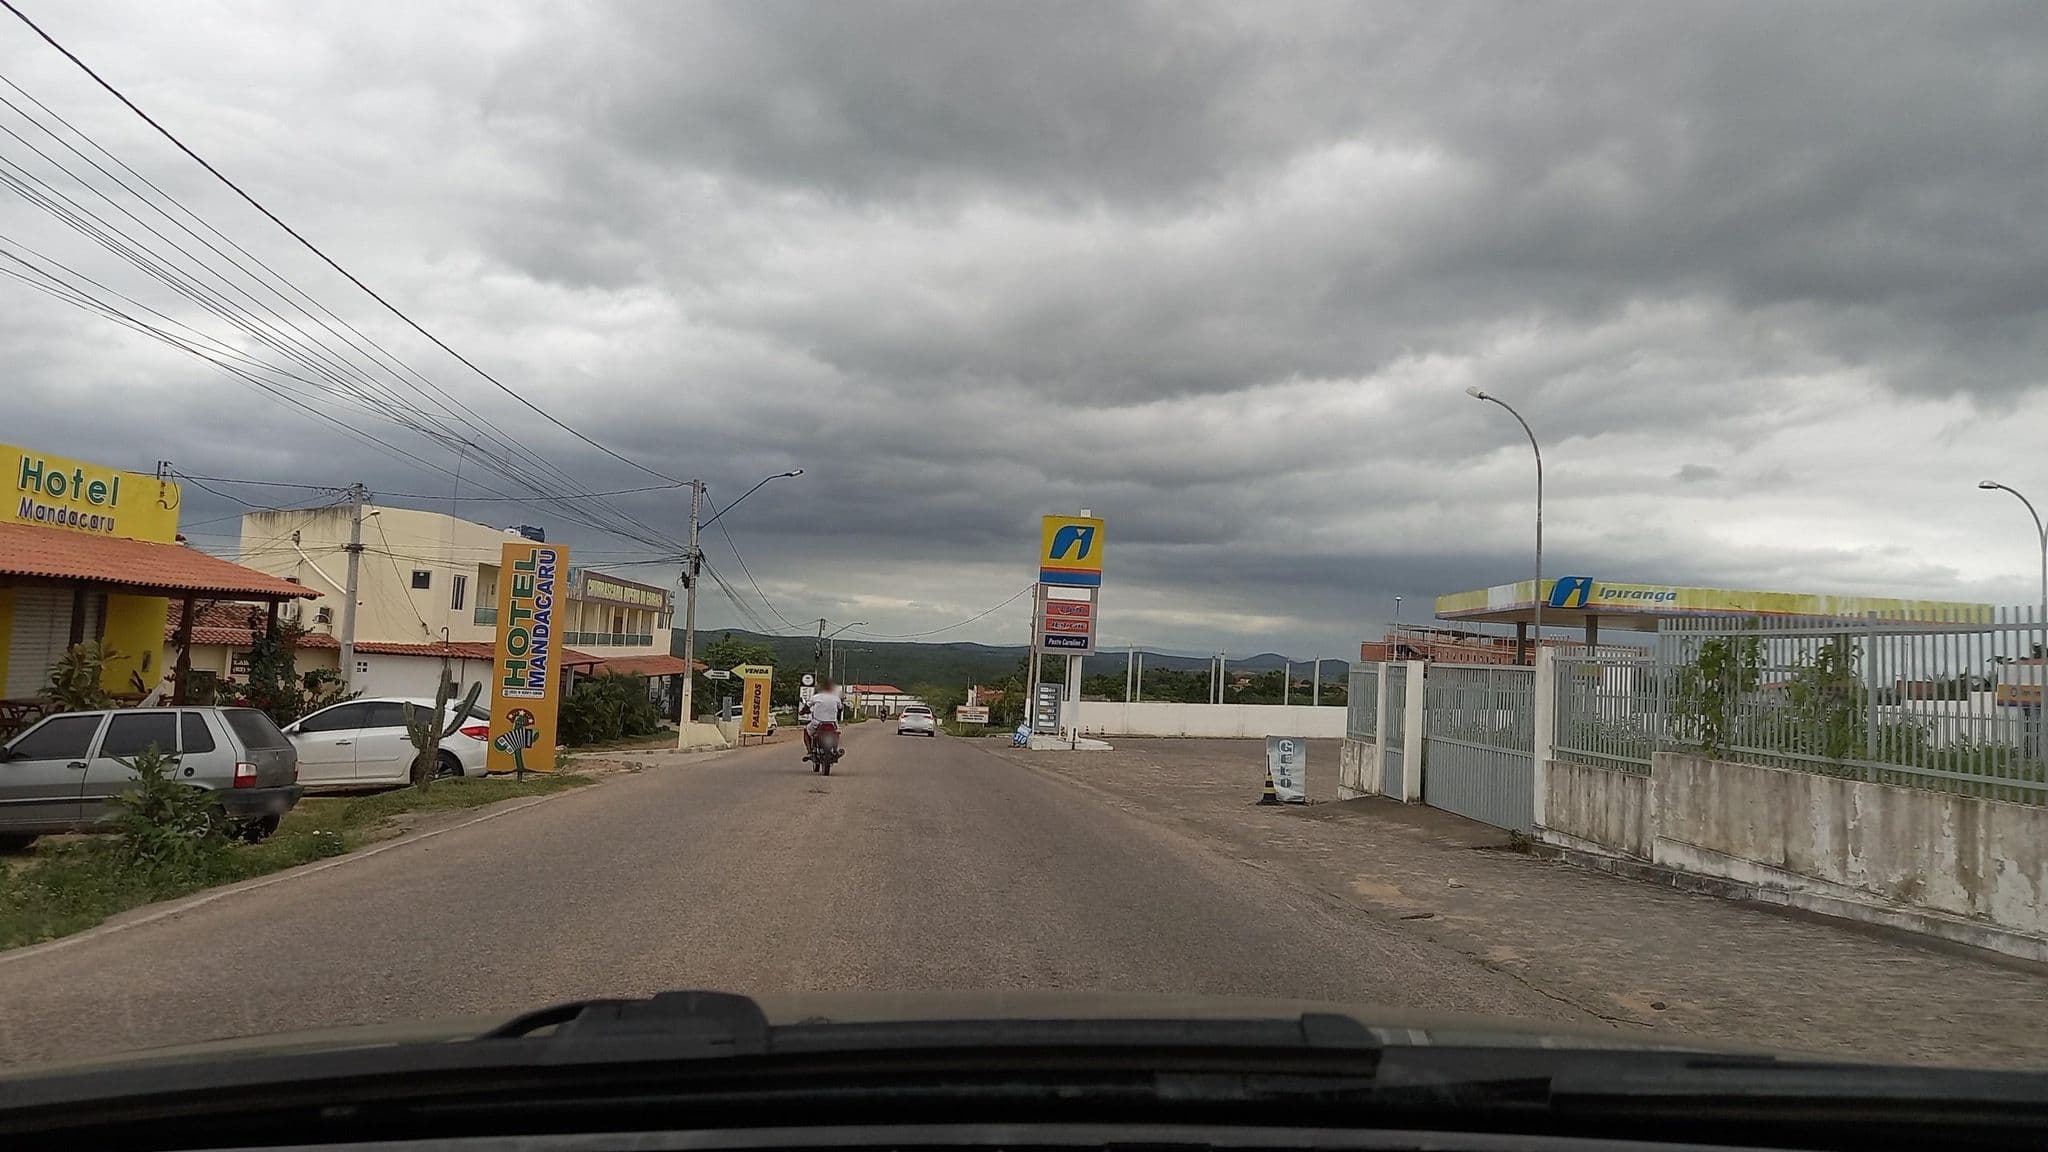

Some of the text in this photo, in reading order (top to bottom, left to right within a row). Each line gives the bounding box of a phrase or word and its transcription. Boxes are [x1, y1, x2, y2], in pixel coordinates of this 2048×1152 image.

[19, 455, 121, 507] Hotel
[18, 497, 116, 533] Mandacaru
[503, 548, 537, 688] HOTEL
[527, 548, 557, 688] MANDACARU
[1599, 587, 1677, 602] Ipiranga
[752, 683, 762, 728] PASSEIOS
[1280, 741, 1293, 789] GELO
